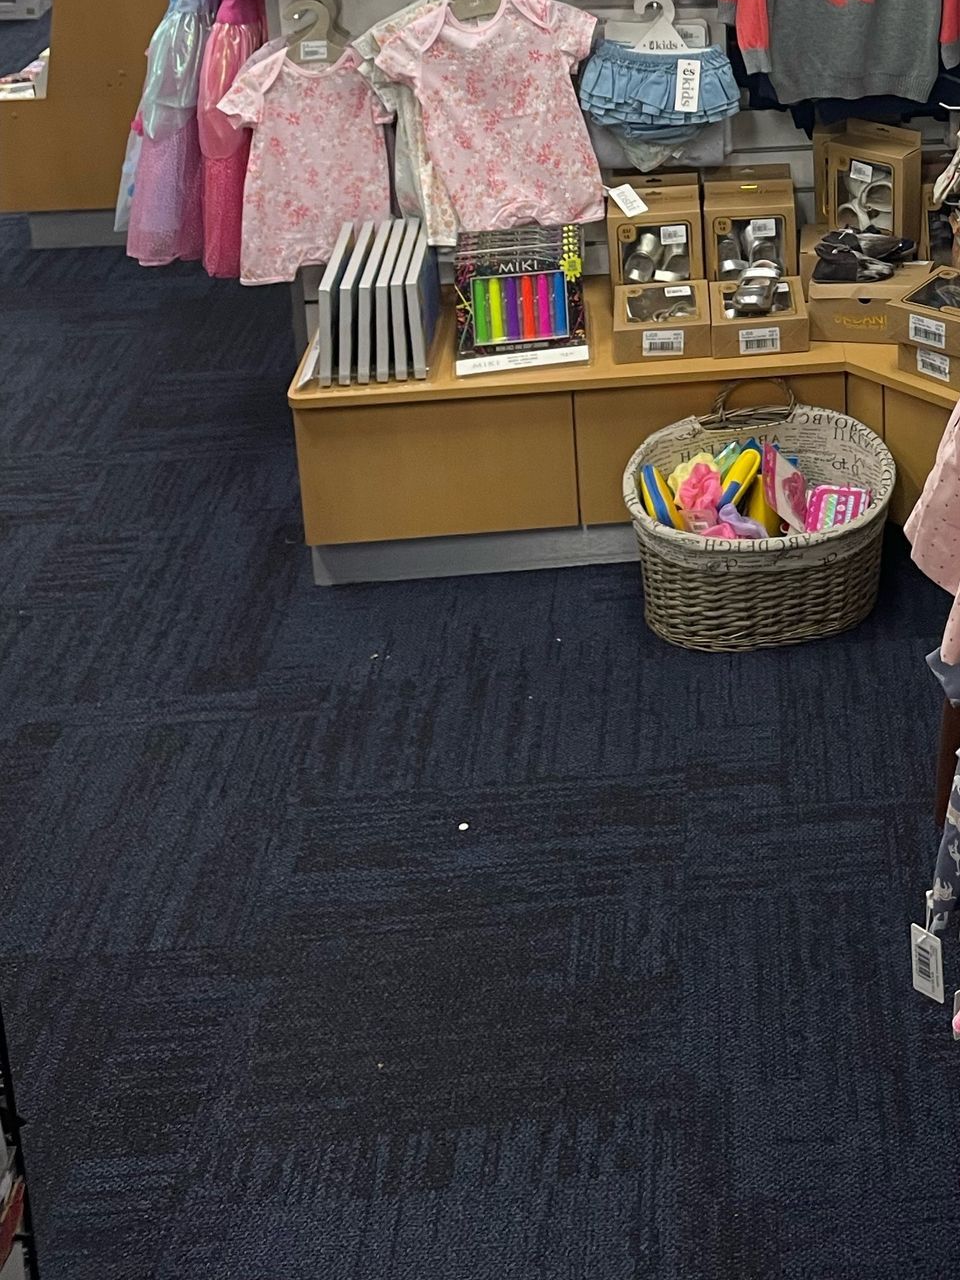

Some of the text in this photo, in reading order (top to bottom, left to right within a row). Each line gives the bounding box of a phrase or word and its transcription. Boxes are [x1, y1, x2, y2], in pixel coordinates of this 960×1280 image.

[655, 41, 678, 50] kids
[683, 67, 695, 76] es
[681, 77, 694, 107] kids
[499, 260, 538, 273] MIKI
